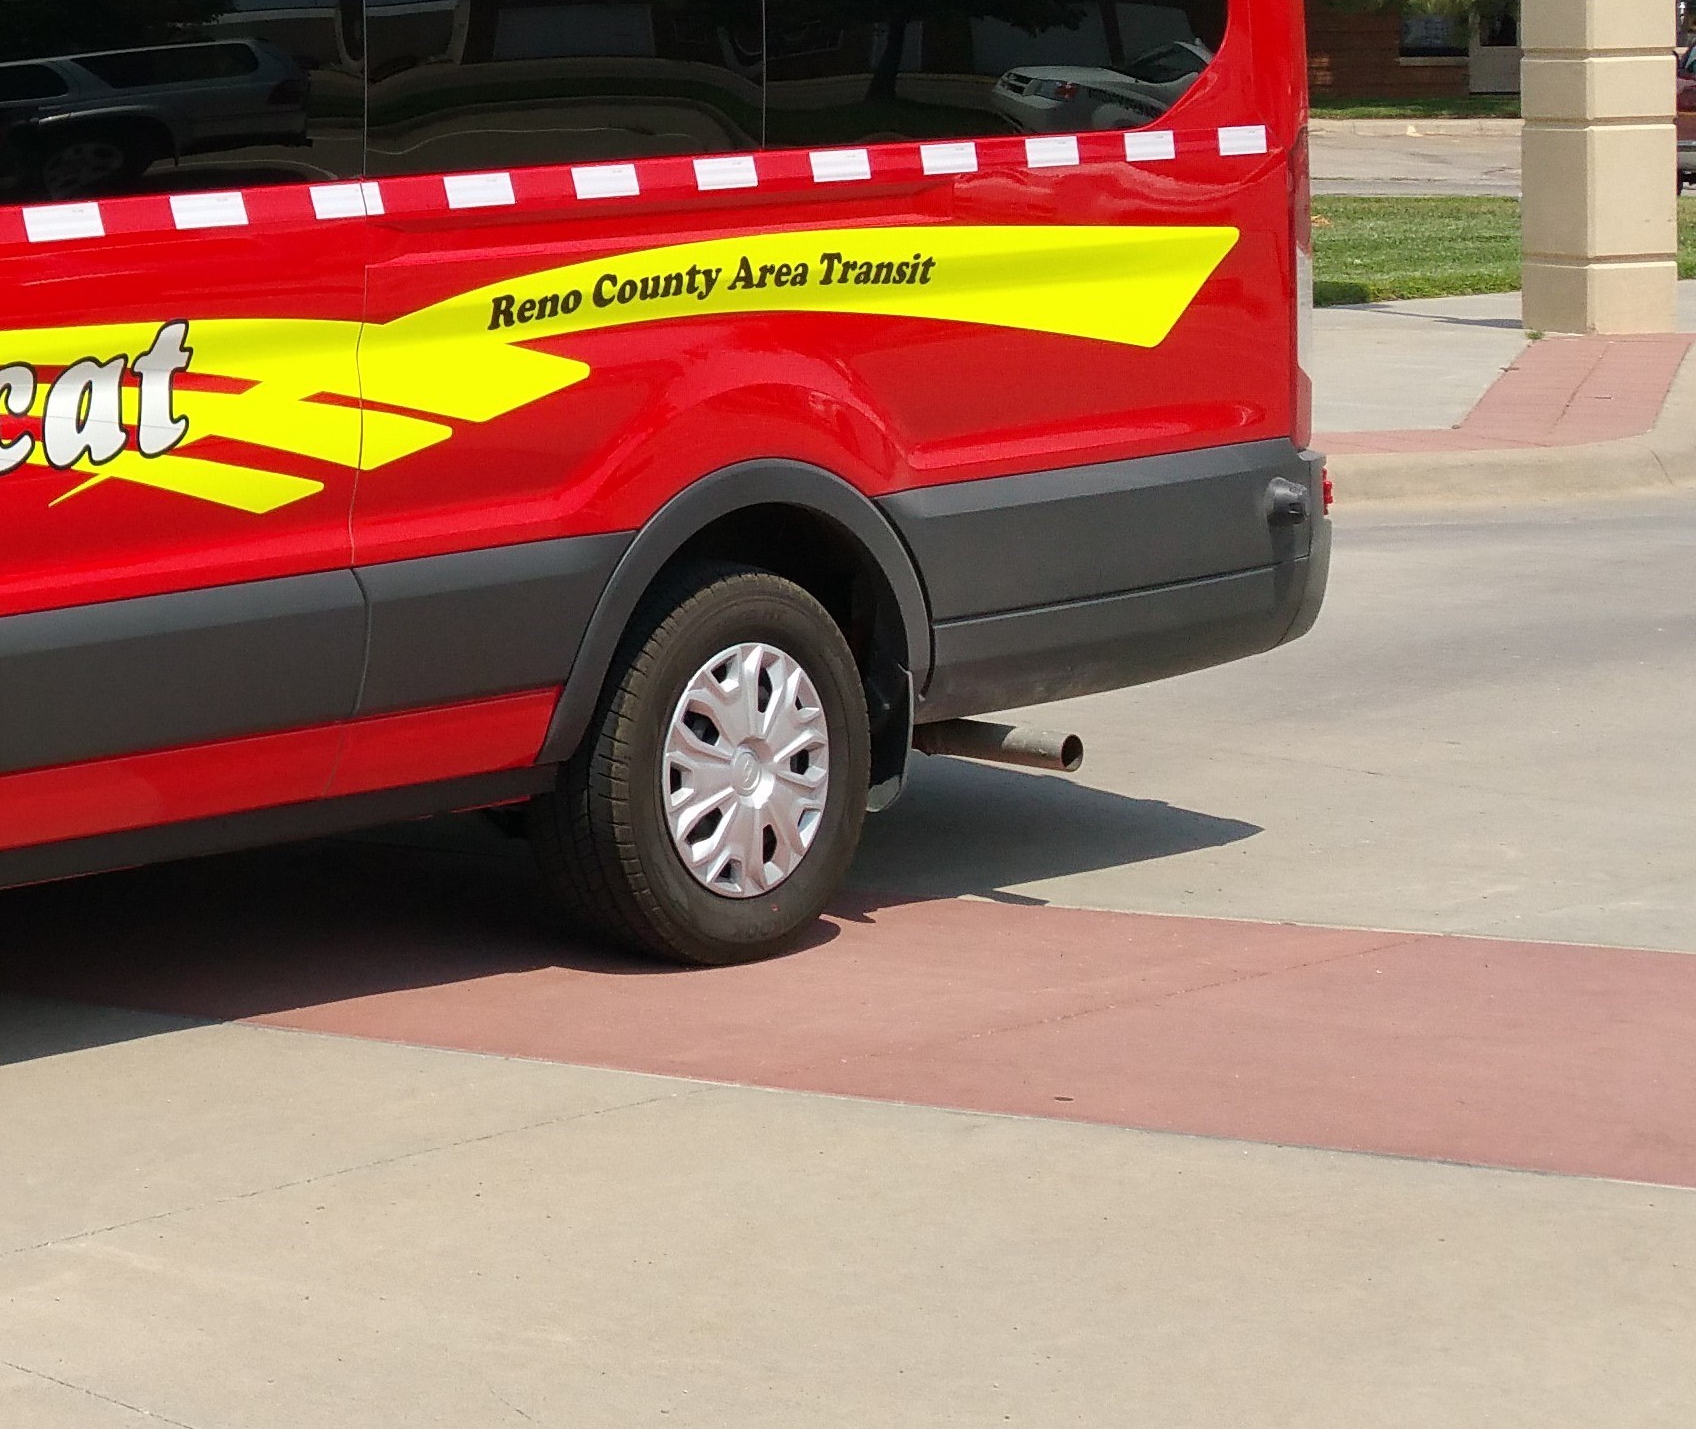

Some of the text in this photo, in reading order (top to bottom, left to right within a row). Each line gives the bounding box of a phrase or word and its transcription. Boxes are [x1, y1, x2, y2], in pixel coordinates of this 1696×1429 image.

[487, 252, 936, 330] Reno County Area Transit
